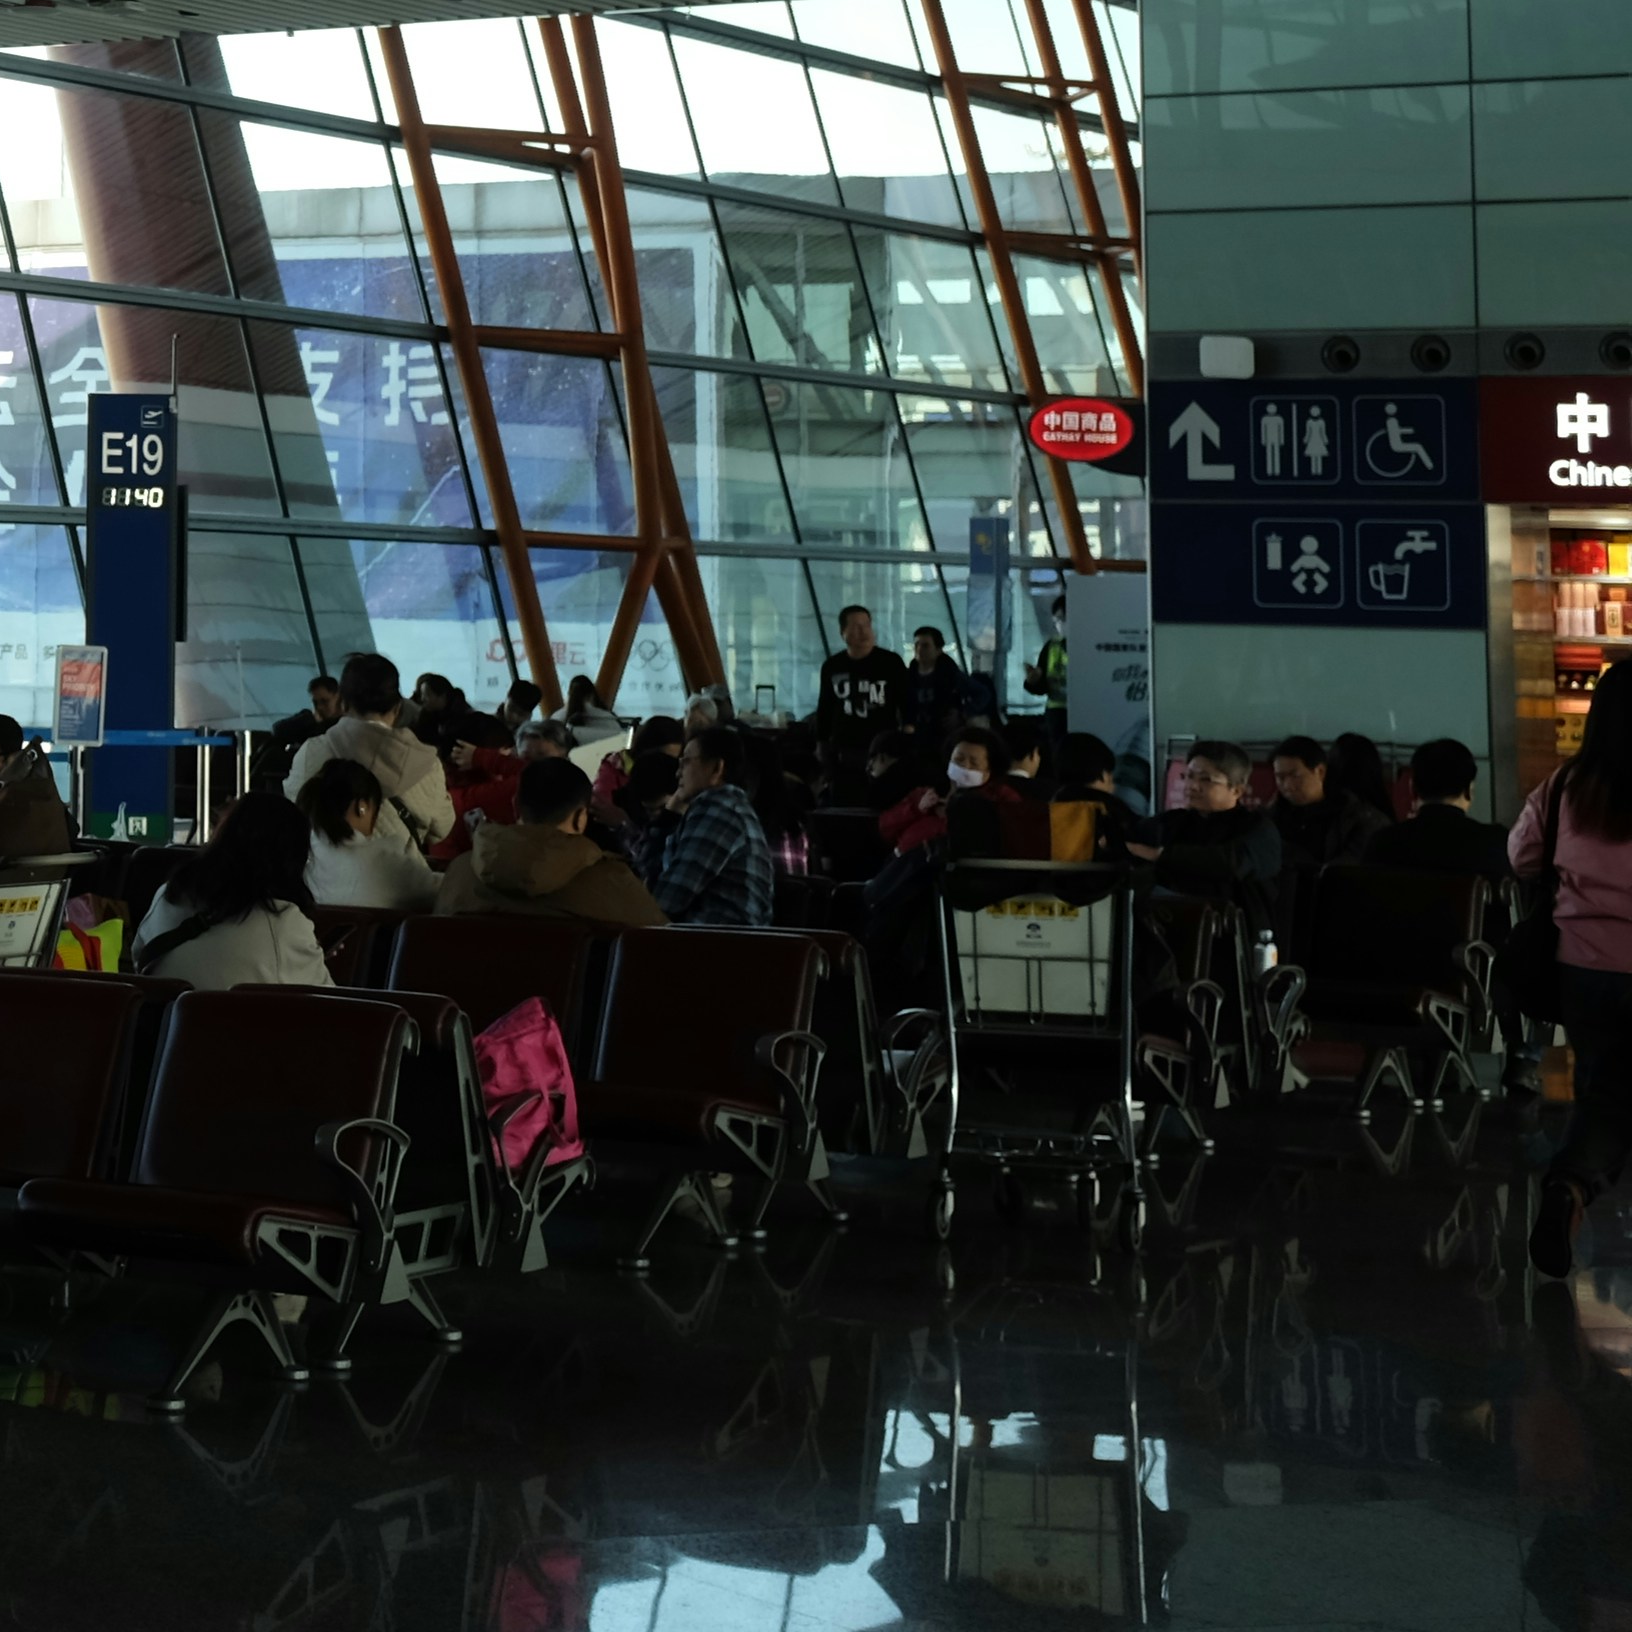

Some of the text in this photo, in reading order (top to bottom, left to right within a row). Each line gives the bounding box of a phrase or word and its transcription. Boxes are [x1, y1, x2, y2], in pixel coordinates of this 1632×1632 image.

[1043, 410, 1117, 432] 中国商品
[101, 432, 164, 476] E19
[1548, 458, 1632, 487] Chine
